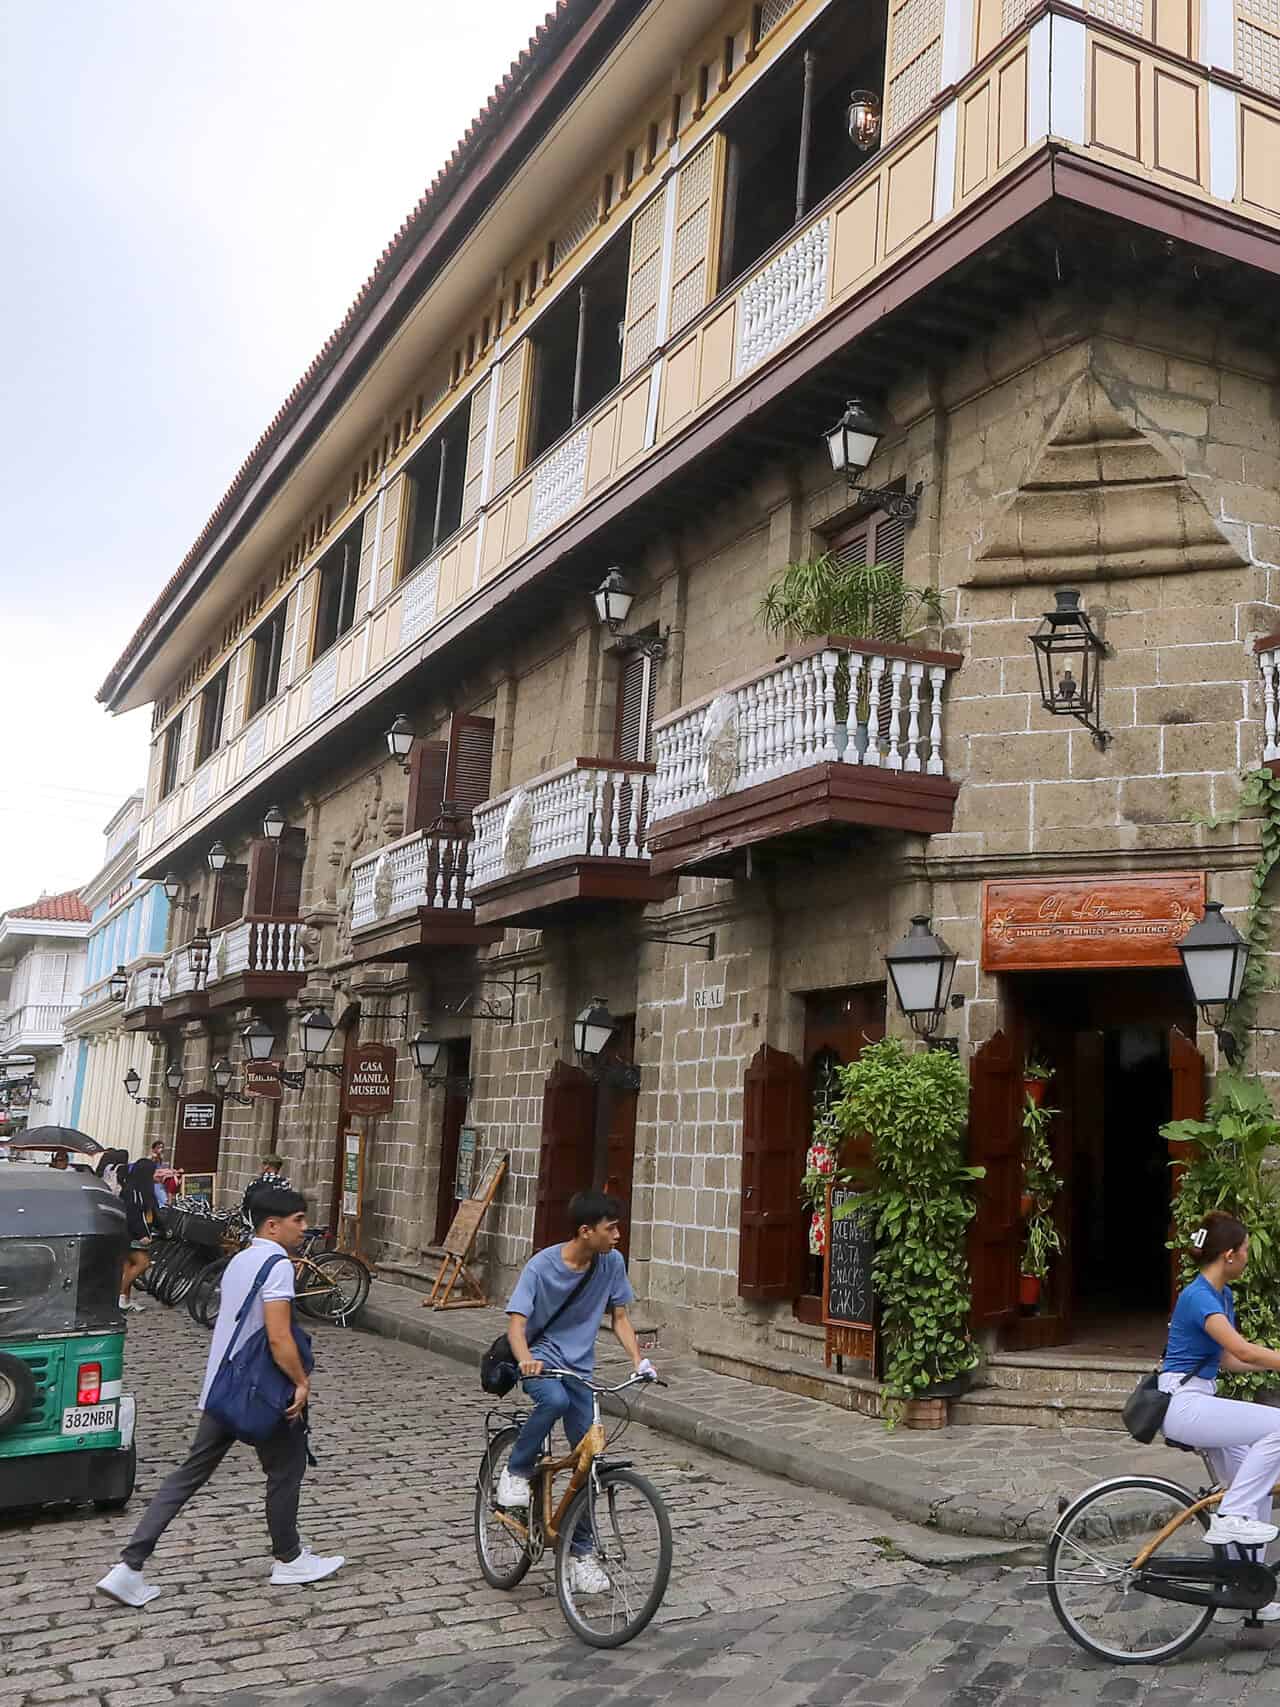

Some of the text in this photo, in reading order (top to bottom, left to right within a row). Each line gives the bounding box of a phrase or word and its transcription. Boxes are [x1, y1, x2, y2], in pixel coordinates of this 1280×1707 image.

[694, 989, 722, 1006] REAL
[360, 1061, 383, 1072] CASA
[352, 1073, 389, 1084] MANILA
[348, 1085, 391, 1096] MUSEUM
[65, 1410, 113, 1429] 382NBR
